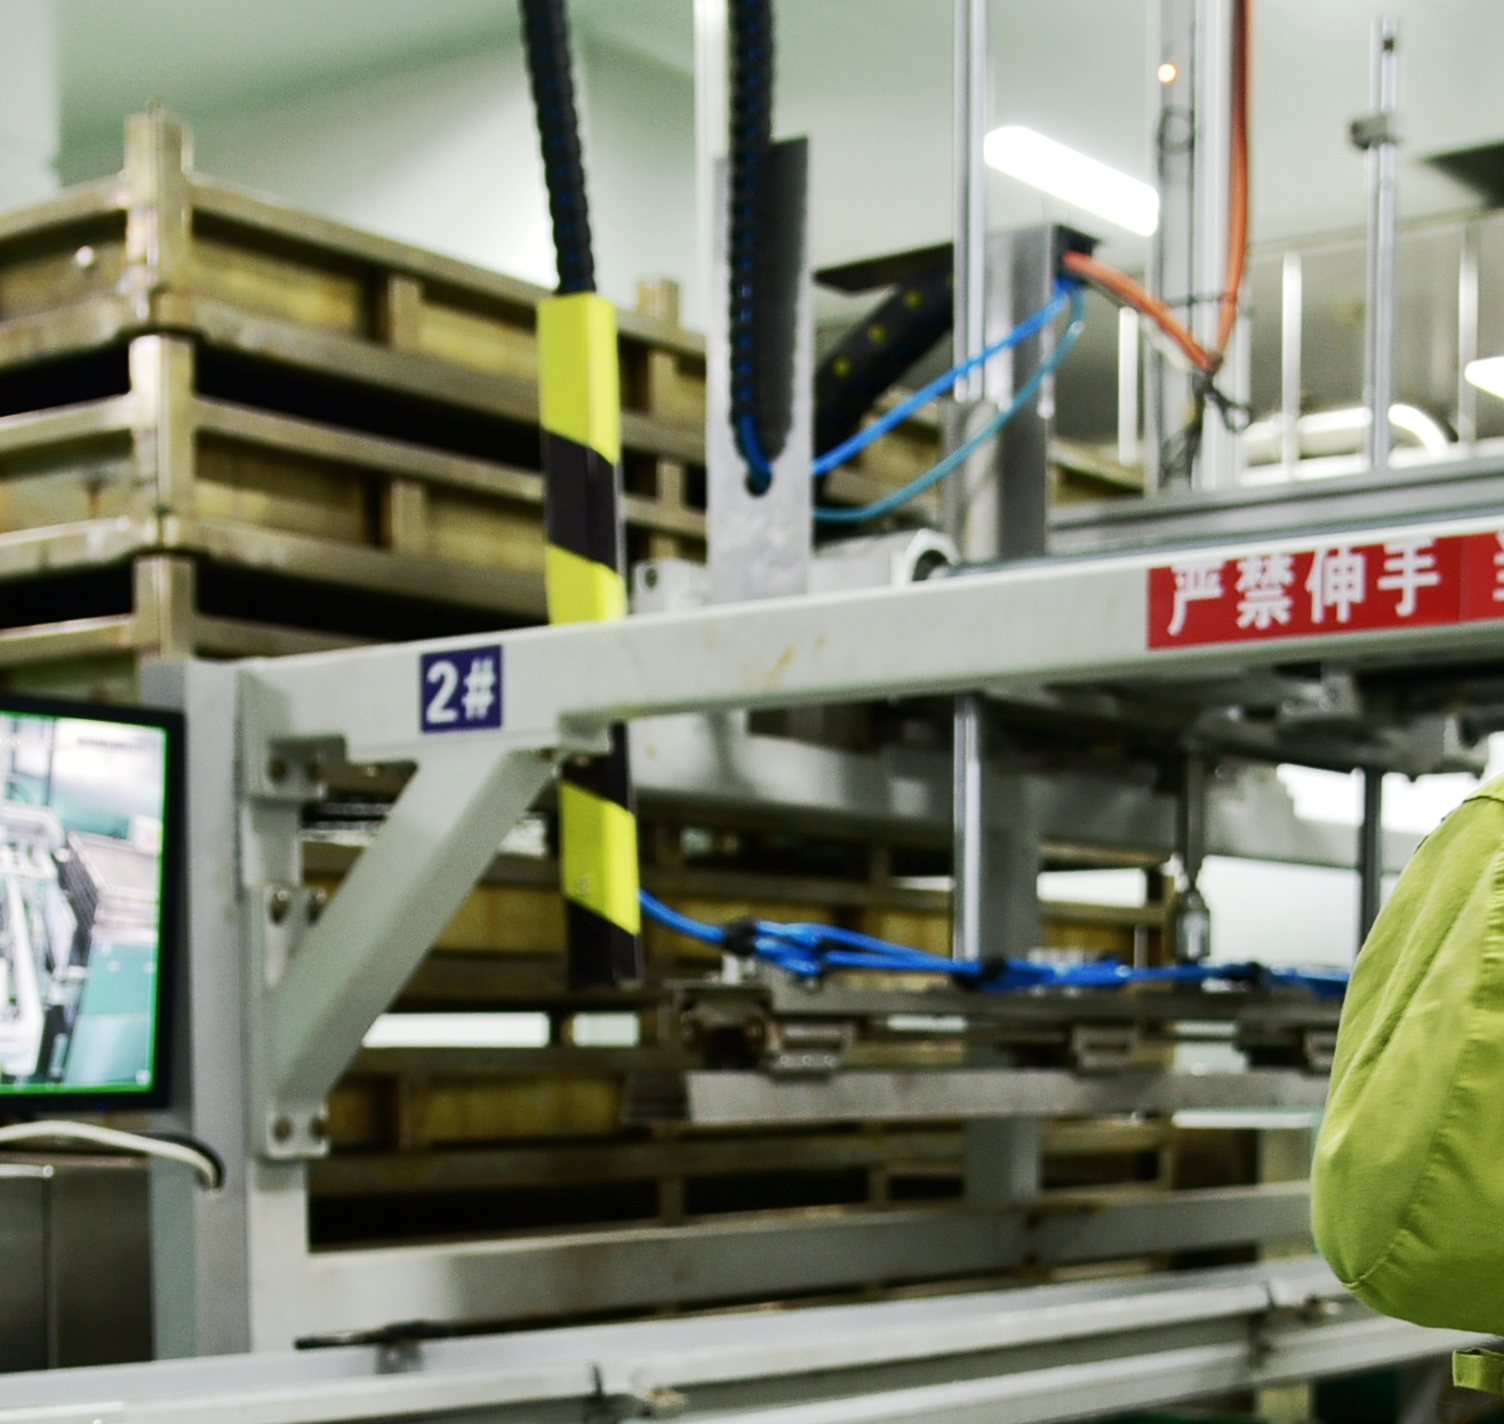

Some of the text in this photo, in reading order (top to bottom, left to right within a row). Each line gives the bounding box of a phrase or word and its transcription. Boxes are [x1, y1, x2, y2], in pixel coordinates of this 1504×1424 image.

[1166, 533, 1442, 638] 严禁伸手
[426, 657, 496, 724] 2#
